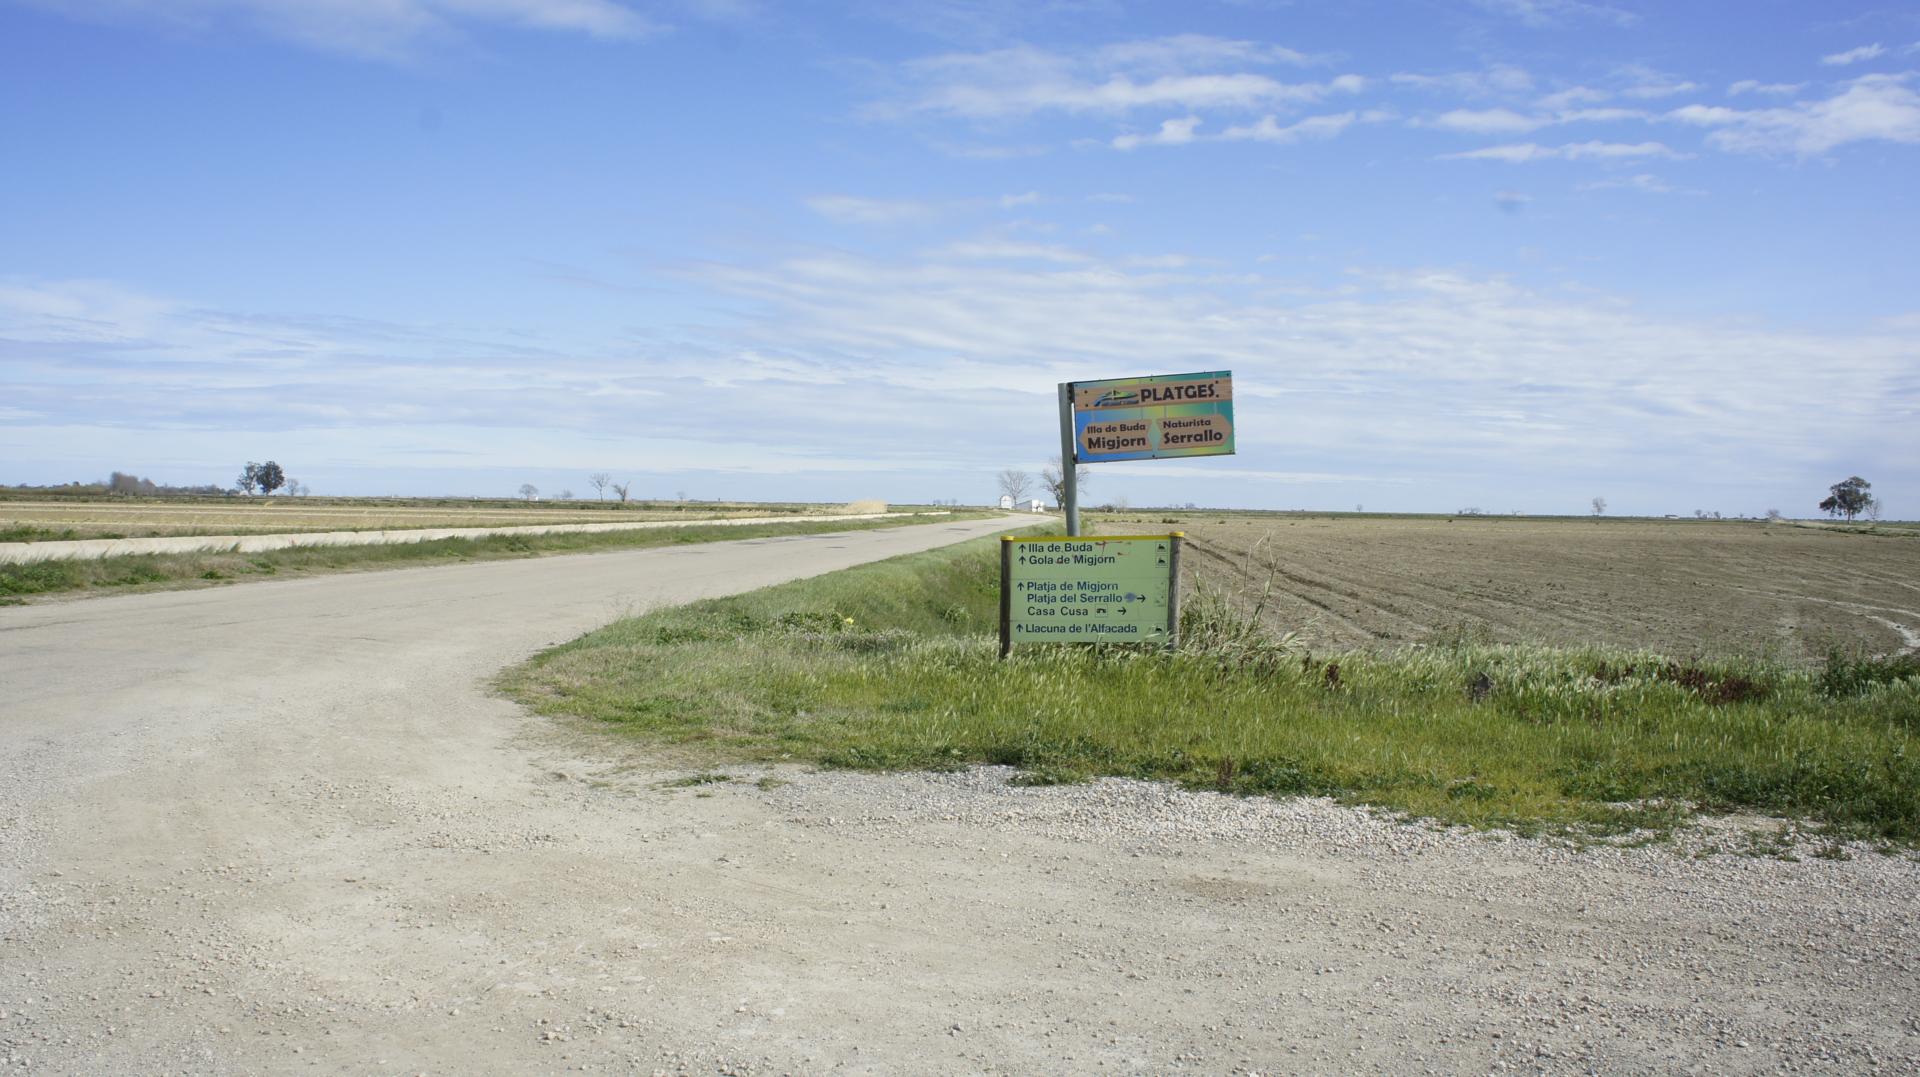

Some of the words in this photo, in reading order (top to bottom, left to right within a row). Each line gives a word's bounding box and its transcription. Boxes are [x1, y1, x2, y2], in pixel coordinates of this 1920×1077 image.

[1140, 383, 1215, 402] PLATGES
[1087, 424, 1103, 434] Illa
[1105, 424, 1117, 433] de
[1120, 422, 1146, 432] Buda
[1163, 418, 1211, 429] Naturista
[1087, 435, 1146, 450] Migjorn
[1163, 429, 1223, 444] Serrallo
[1028, 543, 1045, 553] Illa
[1047, 543, 1061, 552] de
[1064, 542, 1093, 552] Buda
[1029, 555, 1054, 565] Gola
[1057, 555, 1070, 564] de
[1074, 554, 1115, 566] Migjorn
[1027, 581, 1057, 593] Platja
[1059, 581, 1073, 591] de
[1077, 581, 1119, 593] Migjorn
[1027, 593, 1057, 605] Platja
[1059, 593, 1077, 603] del
[1080, 593, 1123, 603] Serrallo
[1027, 606, 1055, 616] Casa
[1060, 606, 1089, 616] Cusa
[1025, 623, 1066, 633] Llacuna
[1069, 623, 1082, 633] de
[1085, 623, 1138, 633] l'Alfacada
